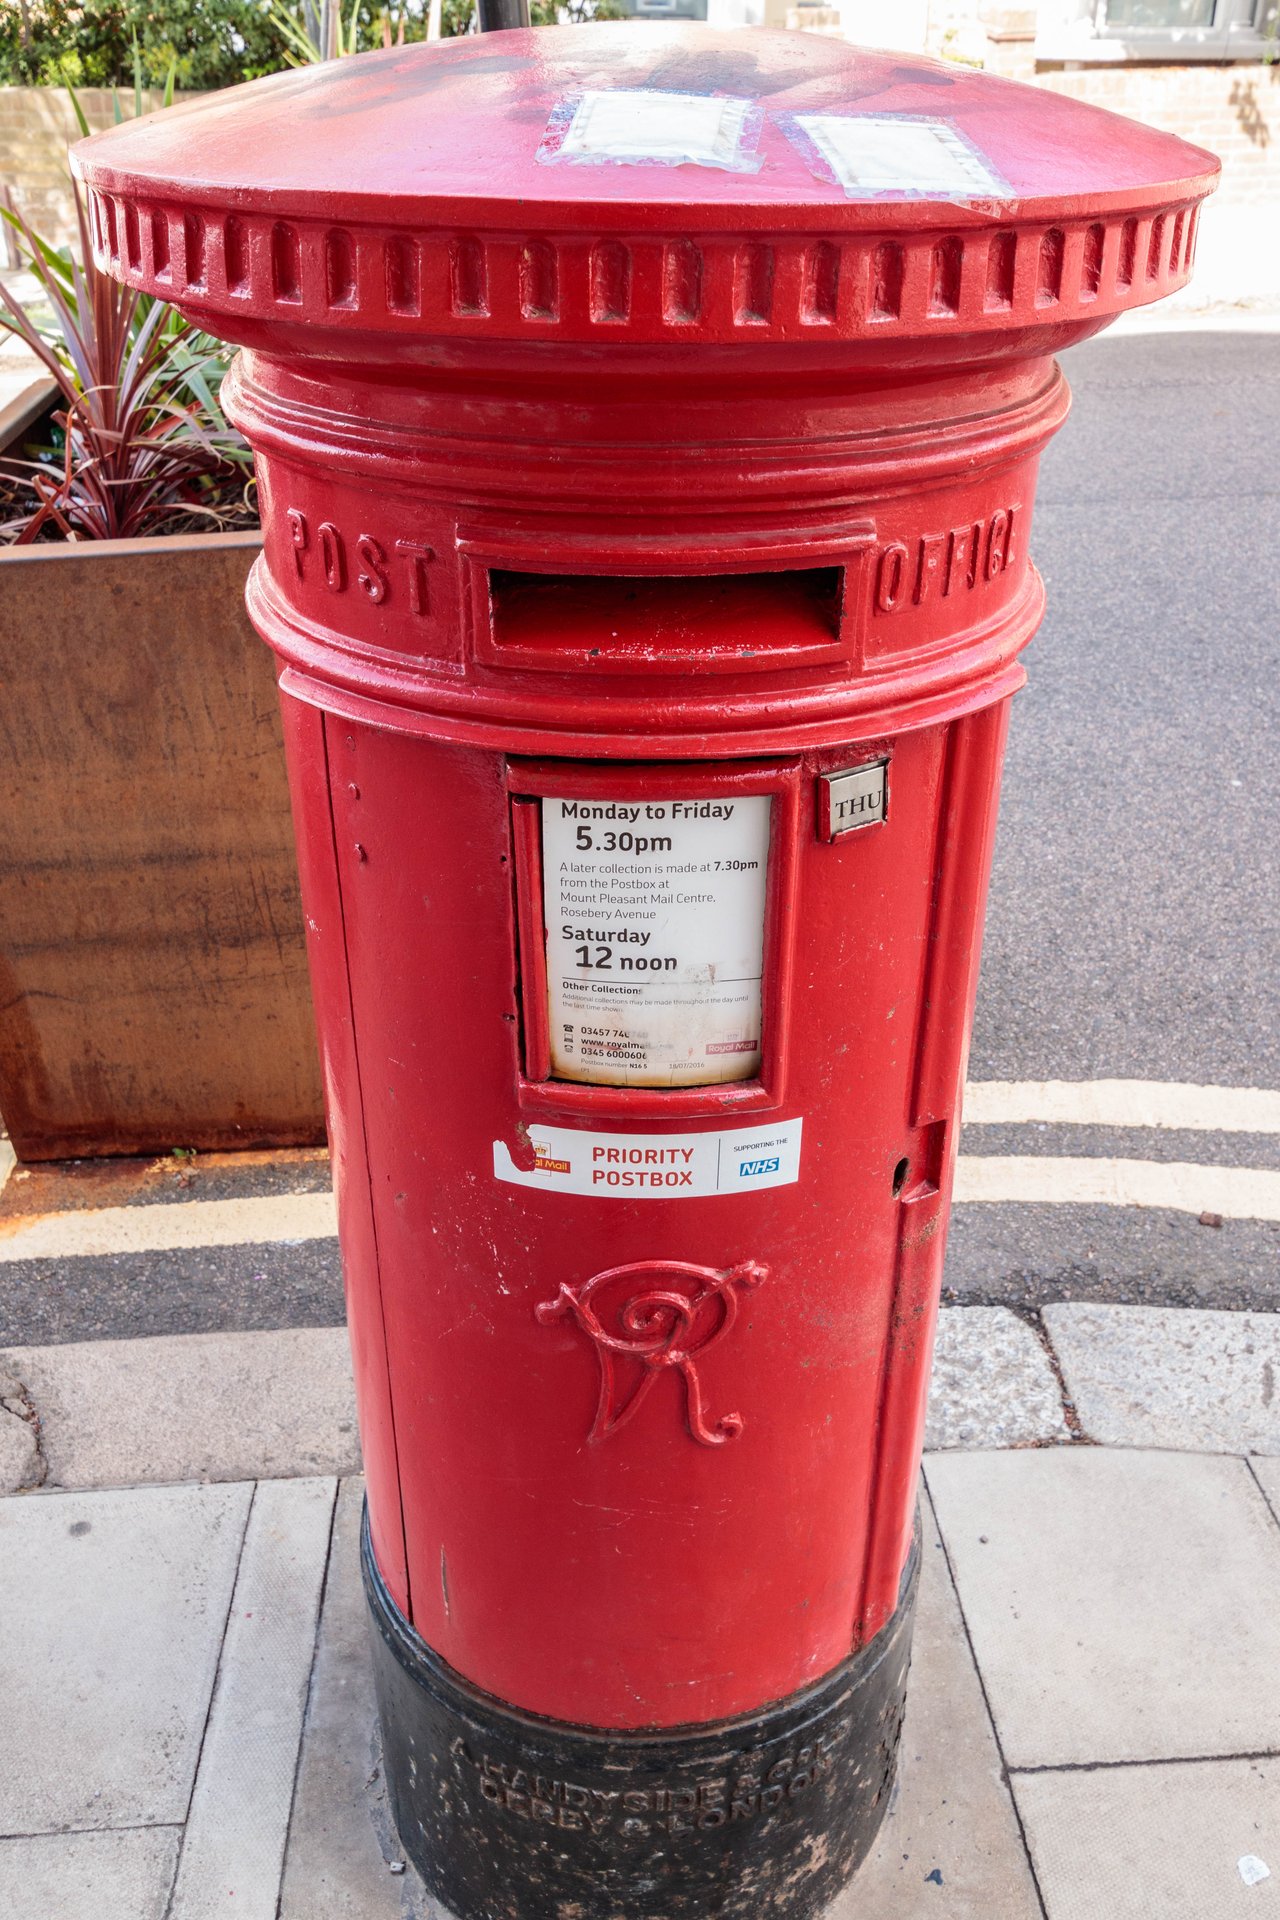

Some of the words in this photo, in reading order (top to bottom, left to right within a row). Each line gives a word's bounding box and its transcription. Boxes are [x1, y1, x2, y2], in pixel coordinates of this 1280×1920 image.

[286, 508, 433, 615] POST
[835, 790, 882, 819] THU
[561, 802, 640, 823] Monday
[645, 803, 666, 820] to
[672, 802, 734, 821] Friday
[575, 825, 672, 855] 5.30pm
[560, 862, 569, 873] A
[571, 863, 597, 874] later
[599, 863, 651, 874] collection
[654, 863, 663, 874] is
[666, 862, 698, 873] made
[700, 862, 711, 872] at
[714, 860, 759, 872] 7.30pm
[560, 877, 587, 888] from
[590, 877, 608, 889] the
[611, 878, 655, 889] Postbox
[659, 880, 670, 889] at
[560, 893, 596, 903] Mount
[600, 893, 647, 905] Pleasant
[651, 893, 674, 904] Mail
[676, 893, 716, 904] Centre.
[560, 907, 612, 920] Rosebery
[614, 909, 656, 919] Avenue
[562, 925, 651, 946] Saturday
[575, 945, 612, 969] 12
[620, 956, 677, 970] noon
[562, 981, 589, 992] Other
[562, 993, 594, 1002] Additional
[595, 997, 628, 1005] collections
[674, 998, 709, 1006] throughout
[722, 996, 733, 1004] day
[574, 1001, 585, 1009] last
[587, 1003, 600, 1011] time
[581, 1026, 610, 1036] 03457
[581, 1047, 604, 1057] 0345
[708, 1043, 734, 1053] Royal
[735, 1041, 755, 1050] Mail
[733, 1140, 775, 1152] SUPPORTING
[776, 1137, 789, 1145] THE
[593, 1146, 695, 1164] PRIORITY
[545, 1161, 568, 1170] Mail
[741, 1158, 778, 1176] NHS
[593, 1170, 693, 1187] POSTBOX
